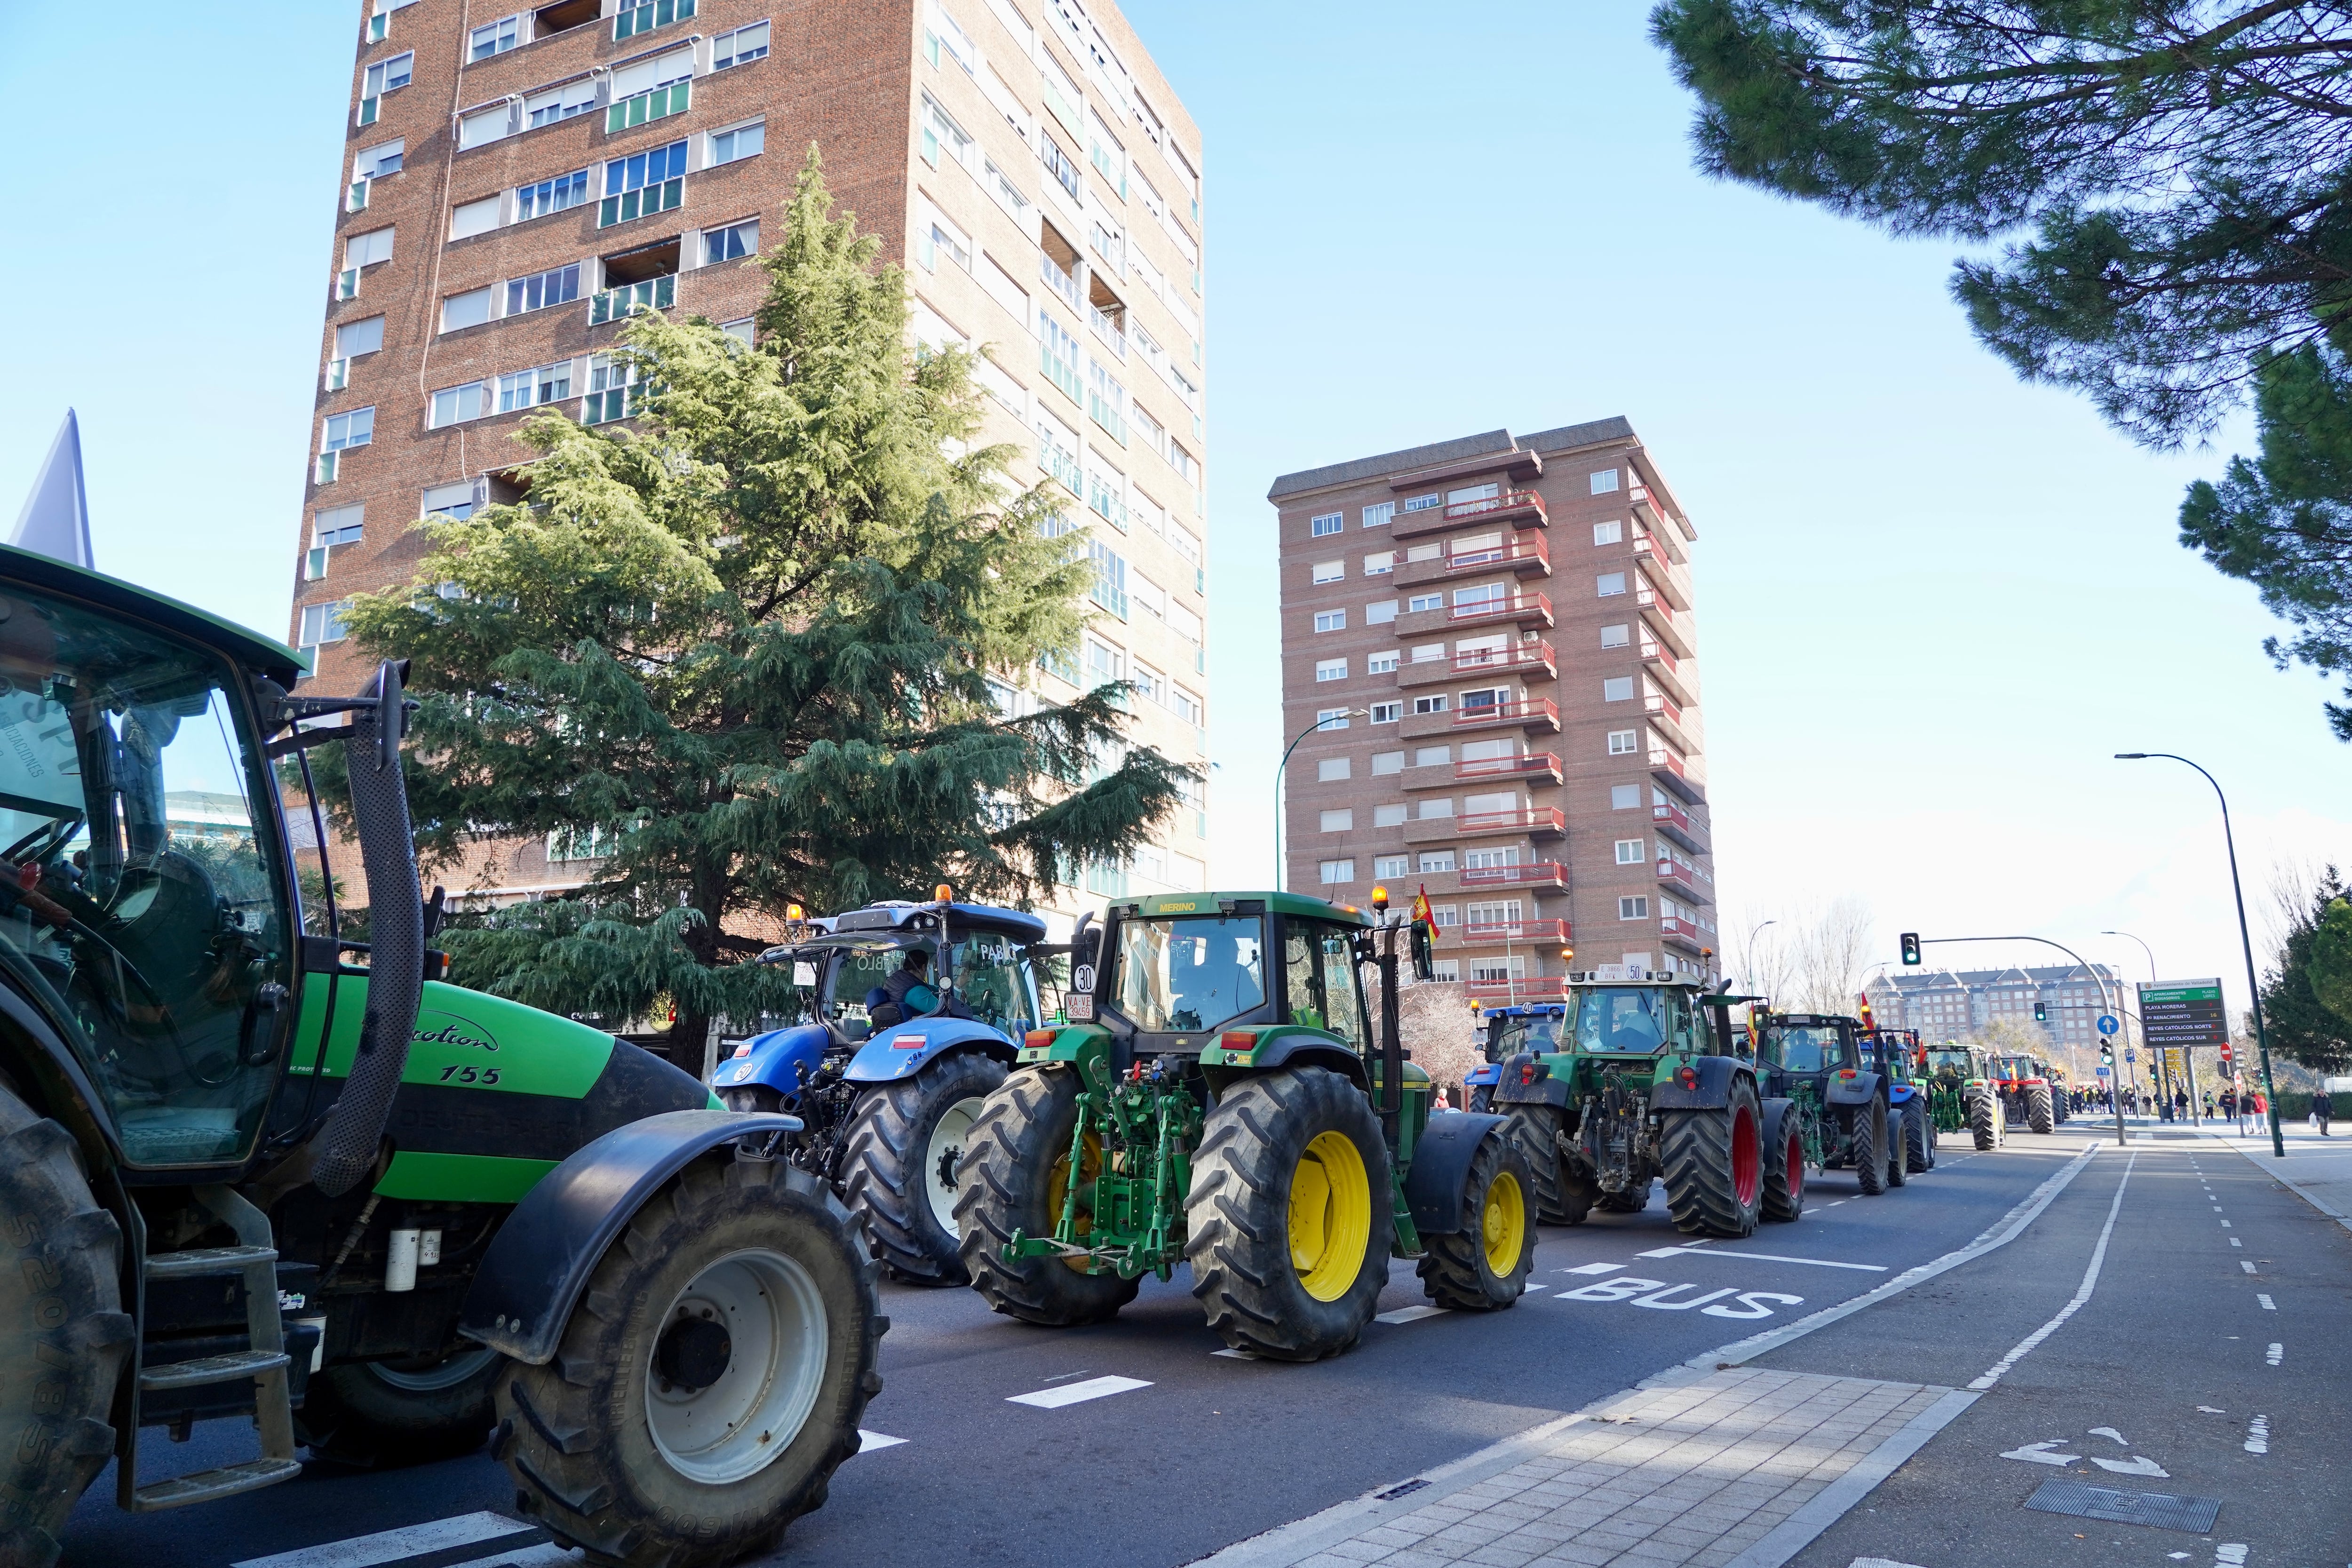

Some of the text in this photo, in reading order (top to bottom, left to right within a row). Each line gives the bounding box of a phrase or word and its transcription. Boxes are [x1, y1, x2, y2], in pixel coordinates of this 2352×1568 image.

[1160, 902, 1196, 912] MERINO
[981, 944, 1016, 961] PABLO
[1079, 968, 1091, 990] 30
[1630, 966, 1640, 979] 50
[1070, 1007, 1090, 1017] 39459
[1524, 1003, 1532, 1012] 40
[1769, 1028, 1776, 1037] 40
[440, 1065, 503, 1085] 155
[1553, 1277, 1805, 1319] BUS
